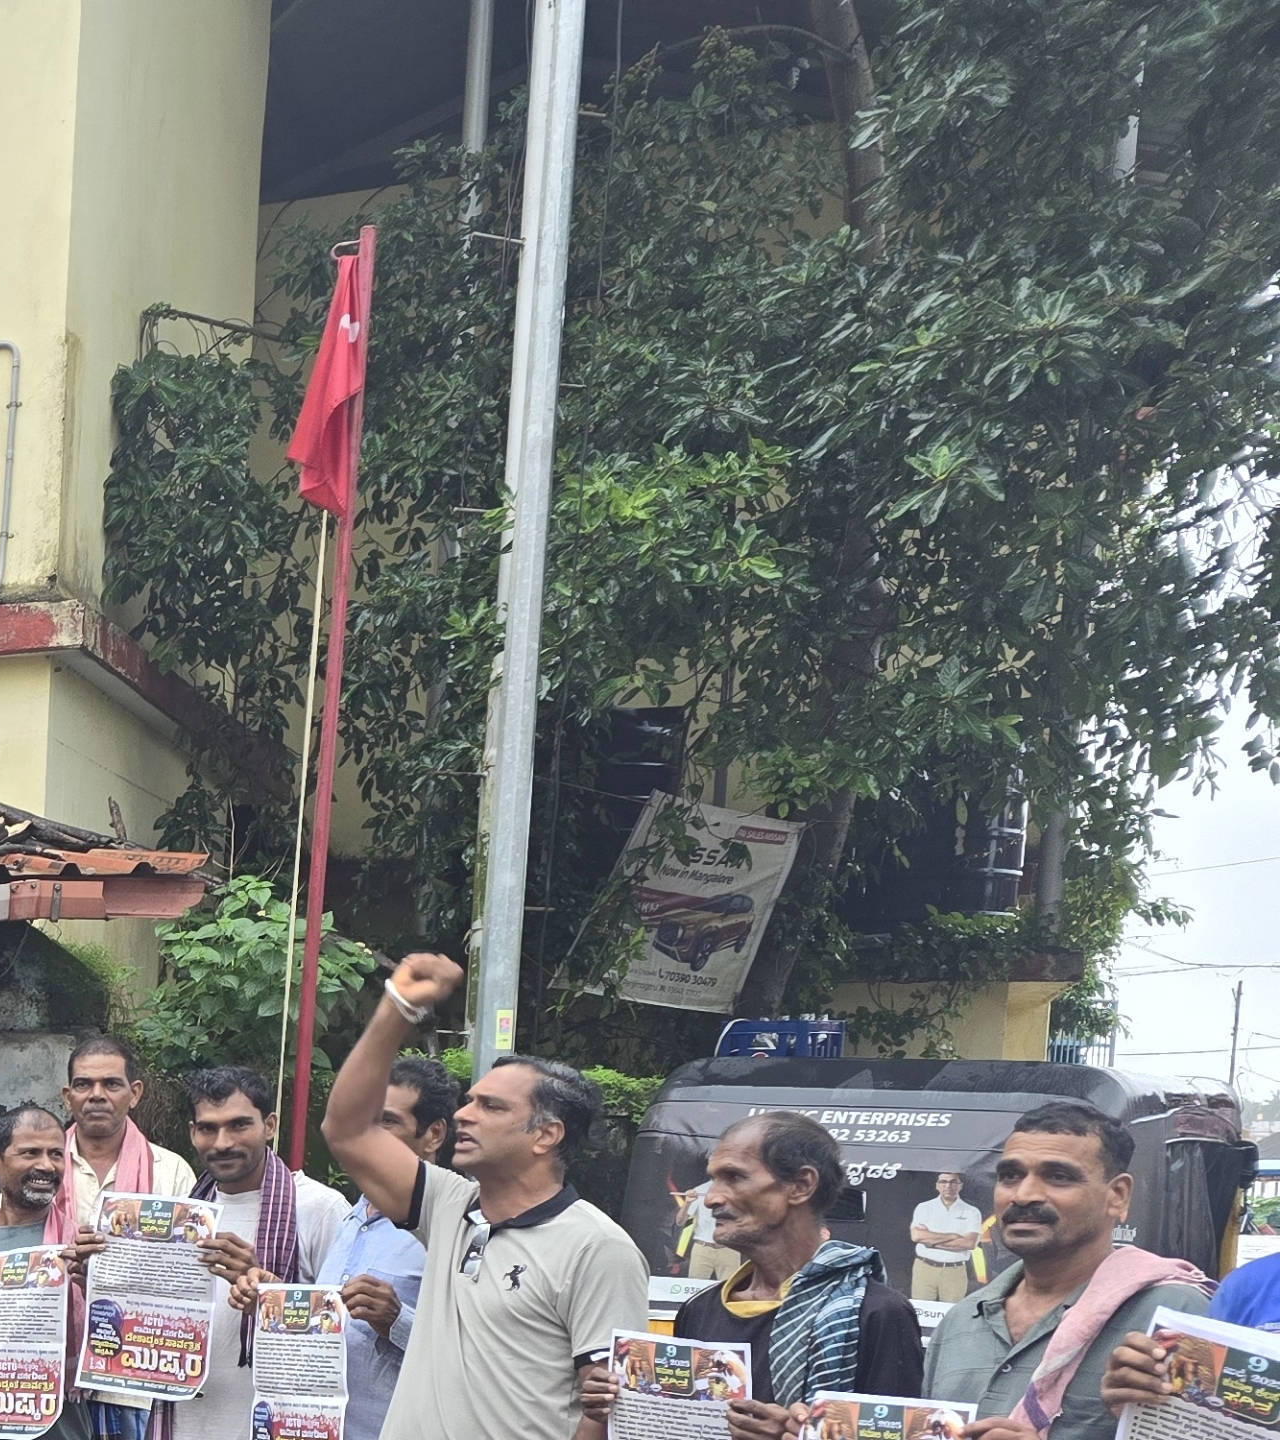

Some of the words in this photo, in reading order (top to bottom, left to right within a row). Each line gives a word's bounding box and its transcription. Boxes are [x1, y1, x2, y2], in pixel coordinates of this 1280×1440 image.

[680, 867, 689, 878] in
[688, 869, 734, 885] Mangalore
[820, 1111, 952, 1127] ENTERPRISES
[853, 1129, 911, 1143] 53263
[1248, 1356, 1268, 1373] 9
